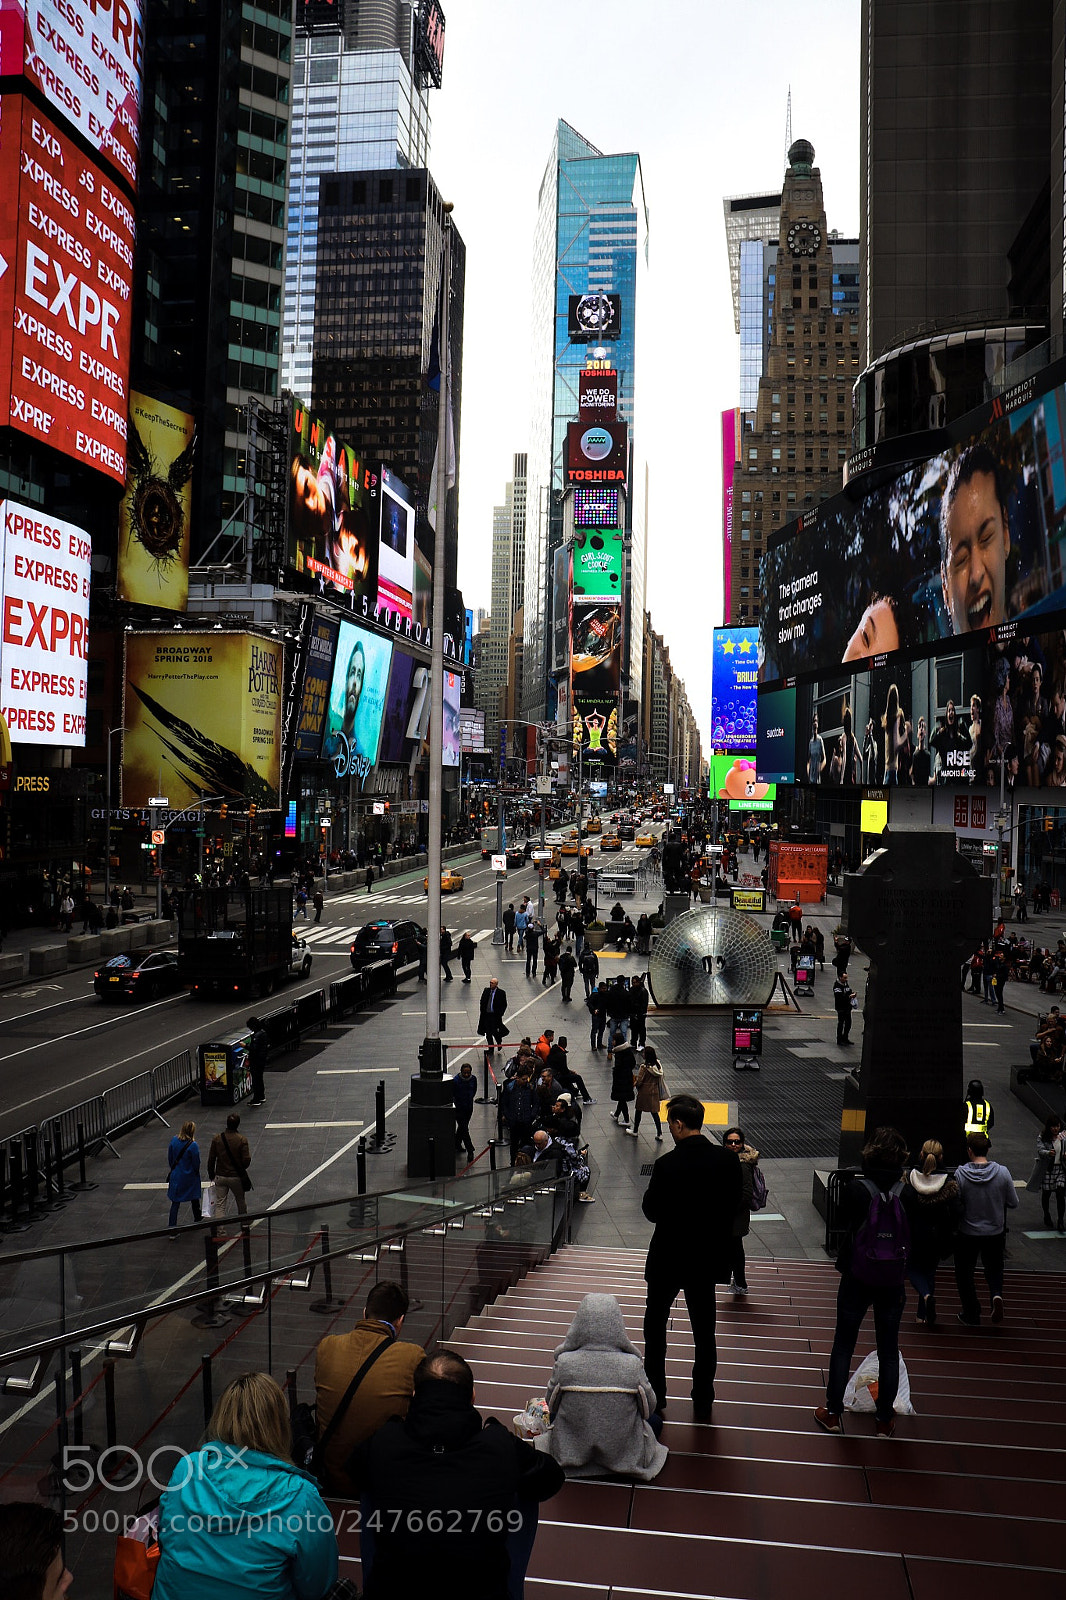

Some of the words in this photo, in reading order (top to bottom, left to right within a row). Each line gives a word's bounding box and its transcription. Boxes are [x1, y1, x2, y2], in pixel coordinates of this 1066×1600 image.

[36, 10, 99, 96] EXPRESS
[88, 111, 137, 181] EXPRESS
[21, 150, 79, 218] XPRESS
[86, 208, 133, 271] EXPRESS
[28, 202, 91, 270] EXPRESS
[14, 306, 73, 362] XPRESS
[22, 355, 85, 411] EXPRESS
[1006, 376, 1036, 401] MARRIOTT
[580, 395, 615, 403] POWER
[1006, 390, 1032, 411] MARQUIS
[76, 430, 124, 477] EXPRESS
[849, 446, 877, 466] MARRIOTT
[568, 470, 625, 480] TOSHIBA
[849, 459, 873, 476] MARQUIS
[588, 561, 608, 569] COOKIE
[596, 552, 615, 562] SCOUT
[14, 555, 78, 594] EXPRESS
[779, 583, 790, 600] The
[791, 570, 818, 594] camera
[778, 603, 792, 622] that
[792, 591, 823, 616] changes
[393, 606, 463, 661] BROAWAY
[778, 627, 794, 645] slow
[794, 622, 805, 639] mo
[154, 655, 190, 663] SPRING
[193, 655, 213, 663] 2018
[251, 645, 279, 675] HARRY
[11, 667, 75, 697] EXPRESS
[147, 673, 219, 681] HarryPotterThePlay.com
[248, 667, 280, 696] POTTER
[305, 676, 328, 697] COME
[299, 712, 323, 733] AWAY
[946, 749, 970, 767] RISE
[14, 776, 50, 791] PRESS
[941, 769, 955, 777] MARCH
[973, 799, 985, 811] UNI
[141, 811, 206, 822] LGGAGE
[973, 814, 985, 826] QLO
